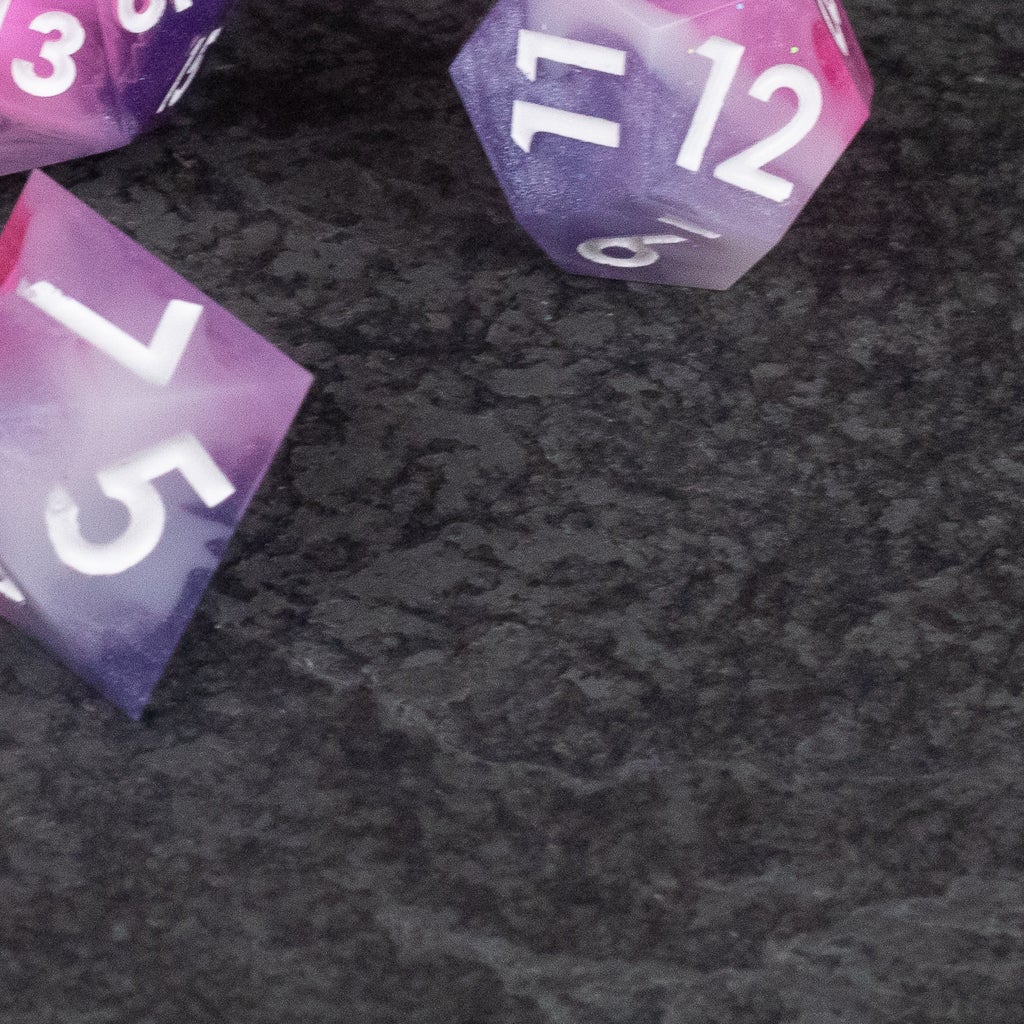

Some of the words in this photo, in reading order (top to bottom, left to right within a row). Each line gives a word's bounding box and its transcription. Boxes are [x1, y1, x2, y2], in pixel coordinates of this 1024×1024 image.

[511, 28, 628, 153] 11
[676, 35, 824, 203] 12
[17, 281, 204, 387] 7
[45, 433, 237, 576] 5
